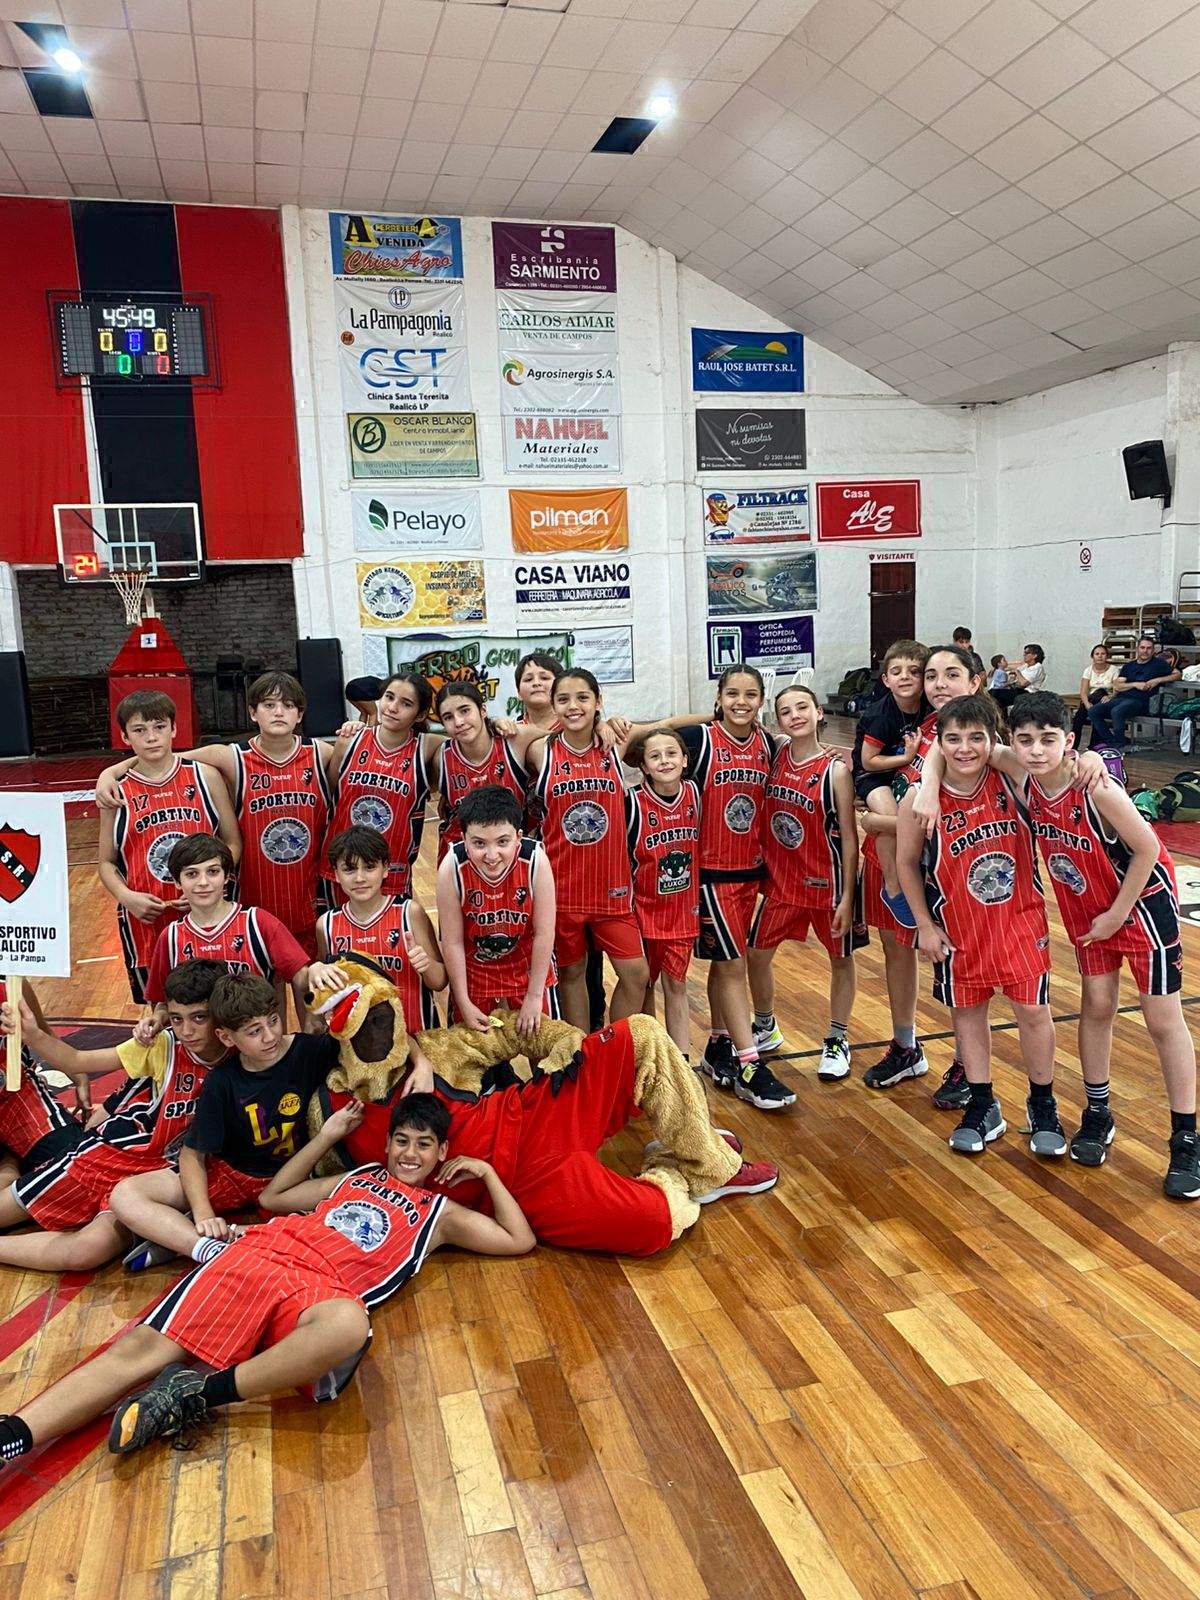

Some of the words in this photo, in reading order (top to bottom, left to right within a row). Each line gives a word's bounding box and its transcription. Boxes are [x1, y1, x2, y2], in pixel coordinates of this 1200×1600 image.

[510, 264, 600, 280] SARMIENTO
[103, 308, 156, 328] 45:49
[501, 313, 562, 326] CARLOS
[566, 316, 616, 328] AIMAR
[100, 332, 113, 351] 0
[129, 332, 141, 351] 0
[154, 333, 168, 352] 0
[119, 354, 131, 373] 0
[157, 355, 170, 374] 0
[698, 362, 722, 371] RAUL
[723, 363, 744, 372] JOSE
[745, 363, 774, 372] BATET
[775, 364, 797, 372] S.R.L.
[527, 369, 594, 381] Agrosinergis
[596, 369, 615, 378] S.A.
[394, 417, 428, 425] OSCAR
[433, 417, 473, 425] BLANCO
[515, 417, 609, 440] NAHUEL
[523, 443, 599, 454] Materiales
[737, 489, 807, 507] FILTRACK
[843, 489, 870, 498] Casa
[393, 510, 466, 536] Pelayo
[530, 507, 609, 529] pilman
[74, 555, 97, 575] 24
[876, 552, 914, 560] VISITANTE
[515, 566, 567, 585] CASA
[573, 563, 630, 583] VIANO
[146, 637, 152, 645] 1
[760, 629, 796, 638] ORTOPEDIA
[759, 645, 802, 654] ACCESORIOS
[358, 750, 369, 764] 8
[716, 747, 732, 764] 13
[554, 760, 572, 776] 14
[250, 774, 271, 790] 20
[348, 771, 411, 797] SPORTIVO
[451, 773, 468, 791] 10
[713, 768, 768, 787] SPORTIV
[552, 778, 617, 798] SPORTIVO
[131, 794, 149, 812] 17
[249, 791, 317, 814] SPORTIVO
[767, 784, 814, 813] PORTIVO
[135, 807, 201, 833] SPORTIVO
[648, 811, 660, 827] 6
[941, 809, 967, 834] 23
[645, 827, 699, 850] SPORTIVO
[663, 879, 687, 889] LUXOR
[0, 926, 57, 940] SPORTIVO
[0, 940, 36, 953] ALICO
[183, 942, 195, 961] 4
[335, 936, 352, 954] 21
[10, 954, 19, 962] La
[20, 954, 46, 963] Pampa
[174, 1072, 196, 1094] 19
[351, 1178, 421, 1227] SPORTIVO
